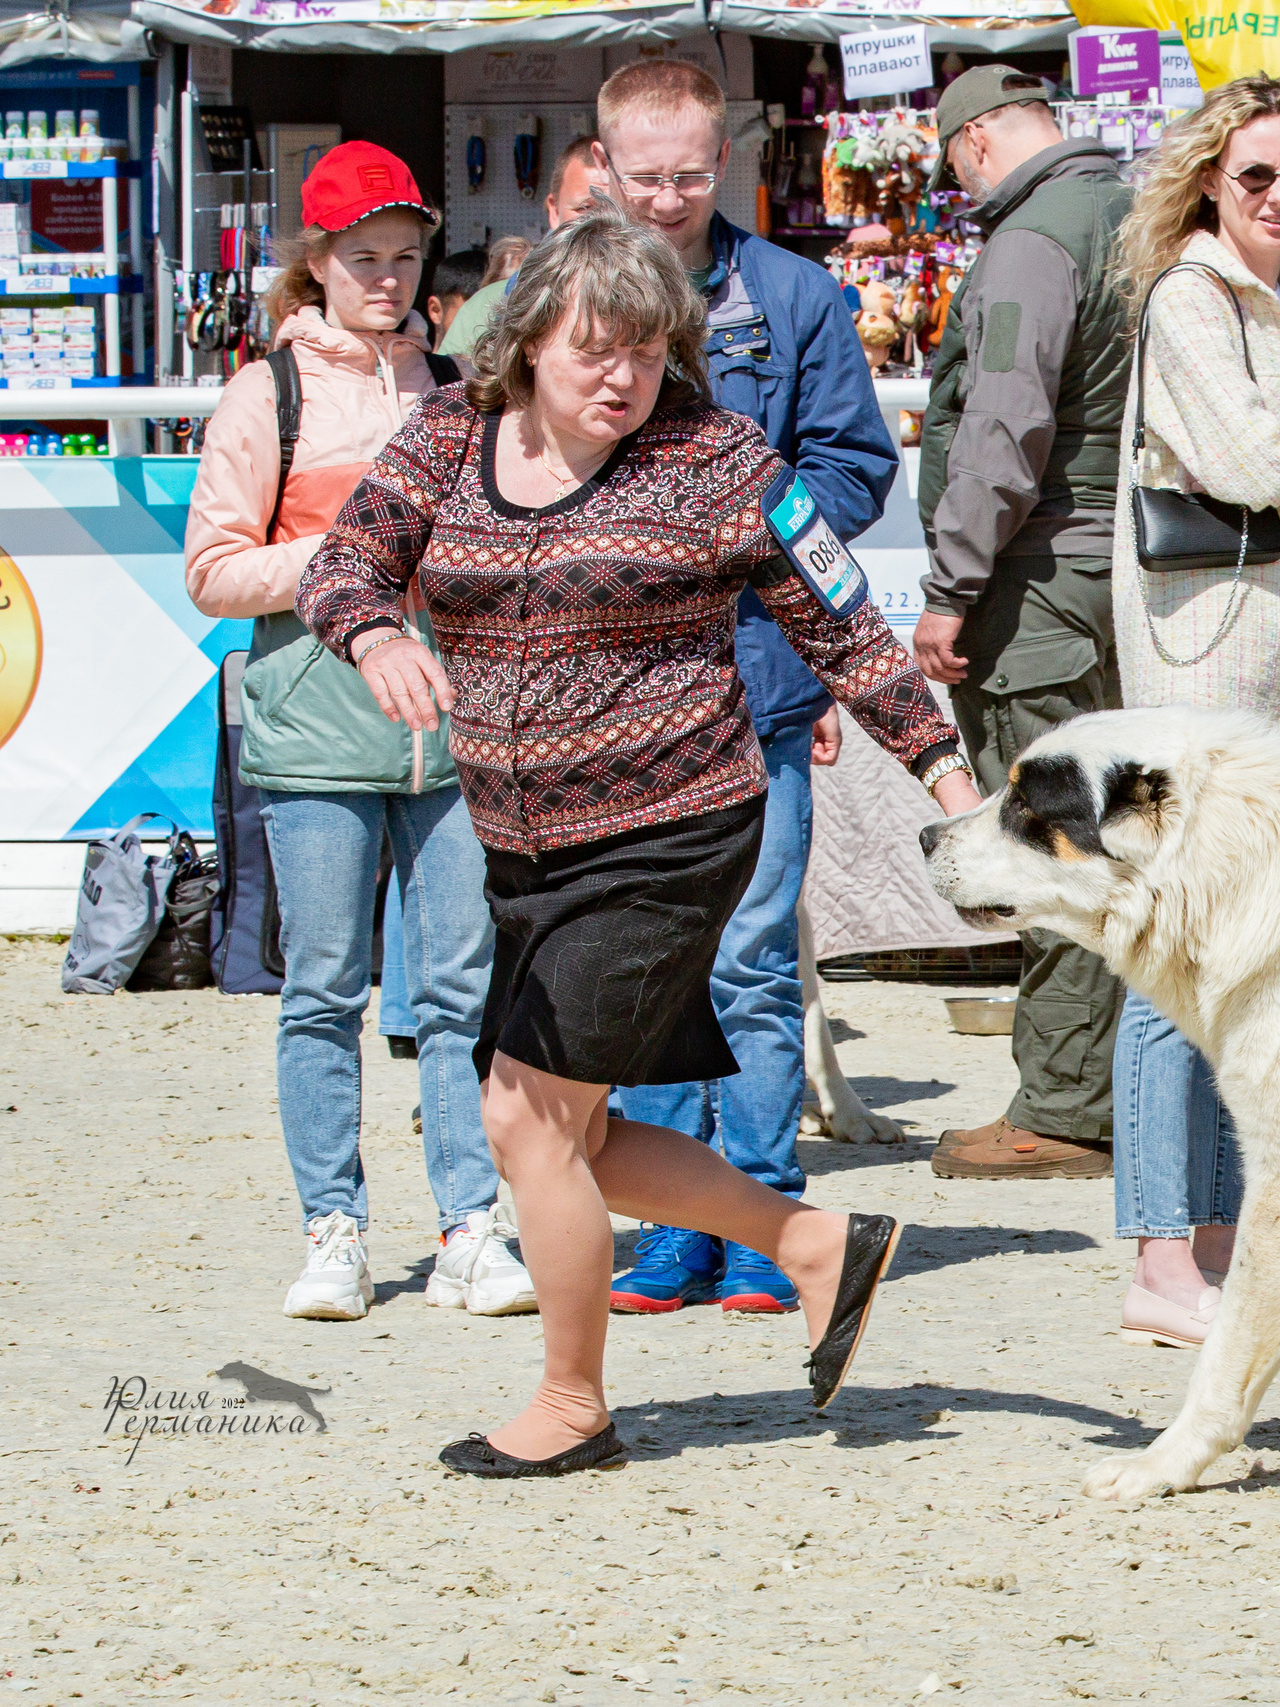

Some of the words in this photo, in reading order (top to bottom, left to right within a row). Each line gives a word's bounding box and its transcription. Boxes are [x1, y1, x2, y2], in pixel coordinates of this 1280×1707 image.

[843, 34, 917, 56] игрушки
[846, 54, 922, 78] плавают
[1162, 56, 1193, 70] игру
[1162, 78, 1199, 88] плава
[809, 530, 840, 574] 086
